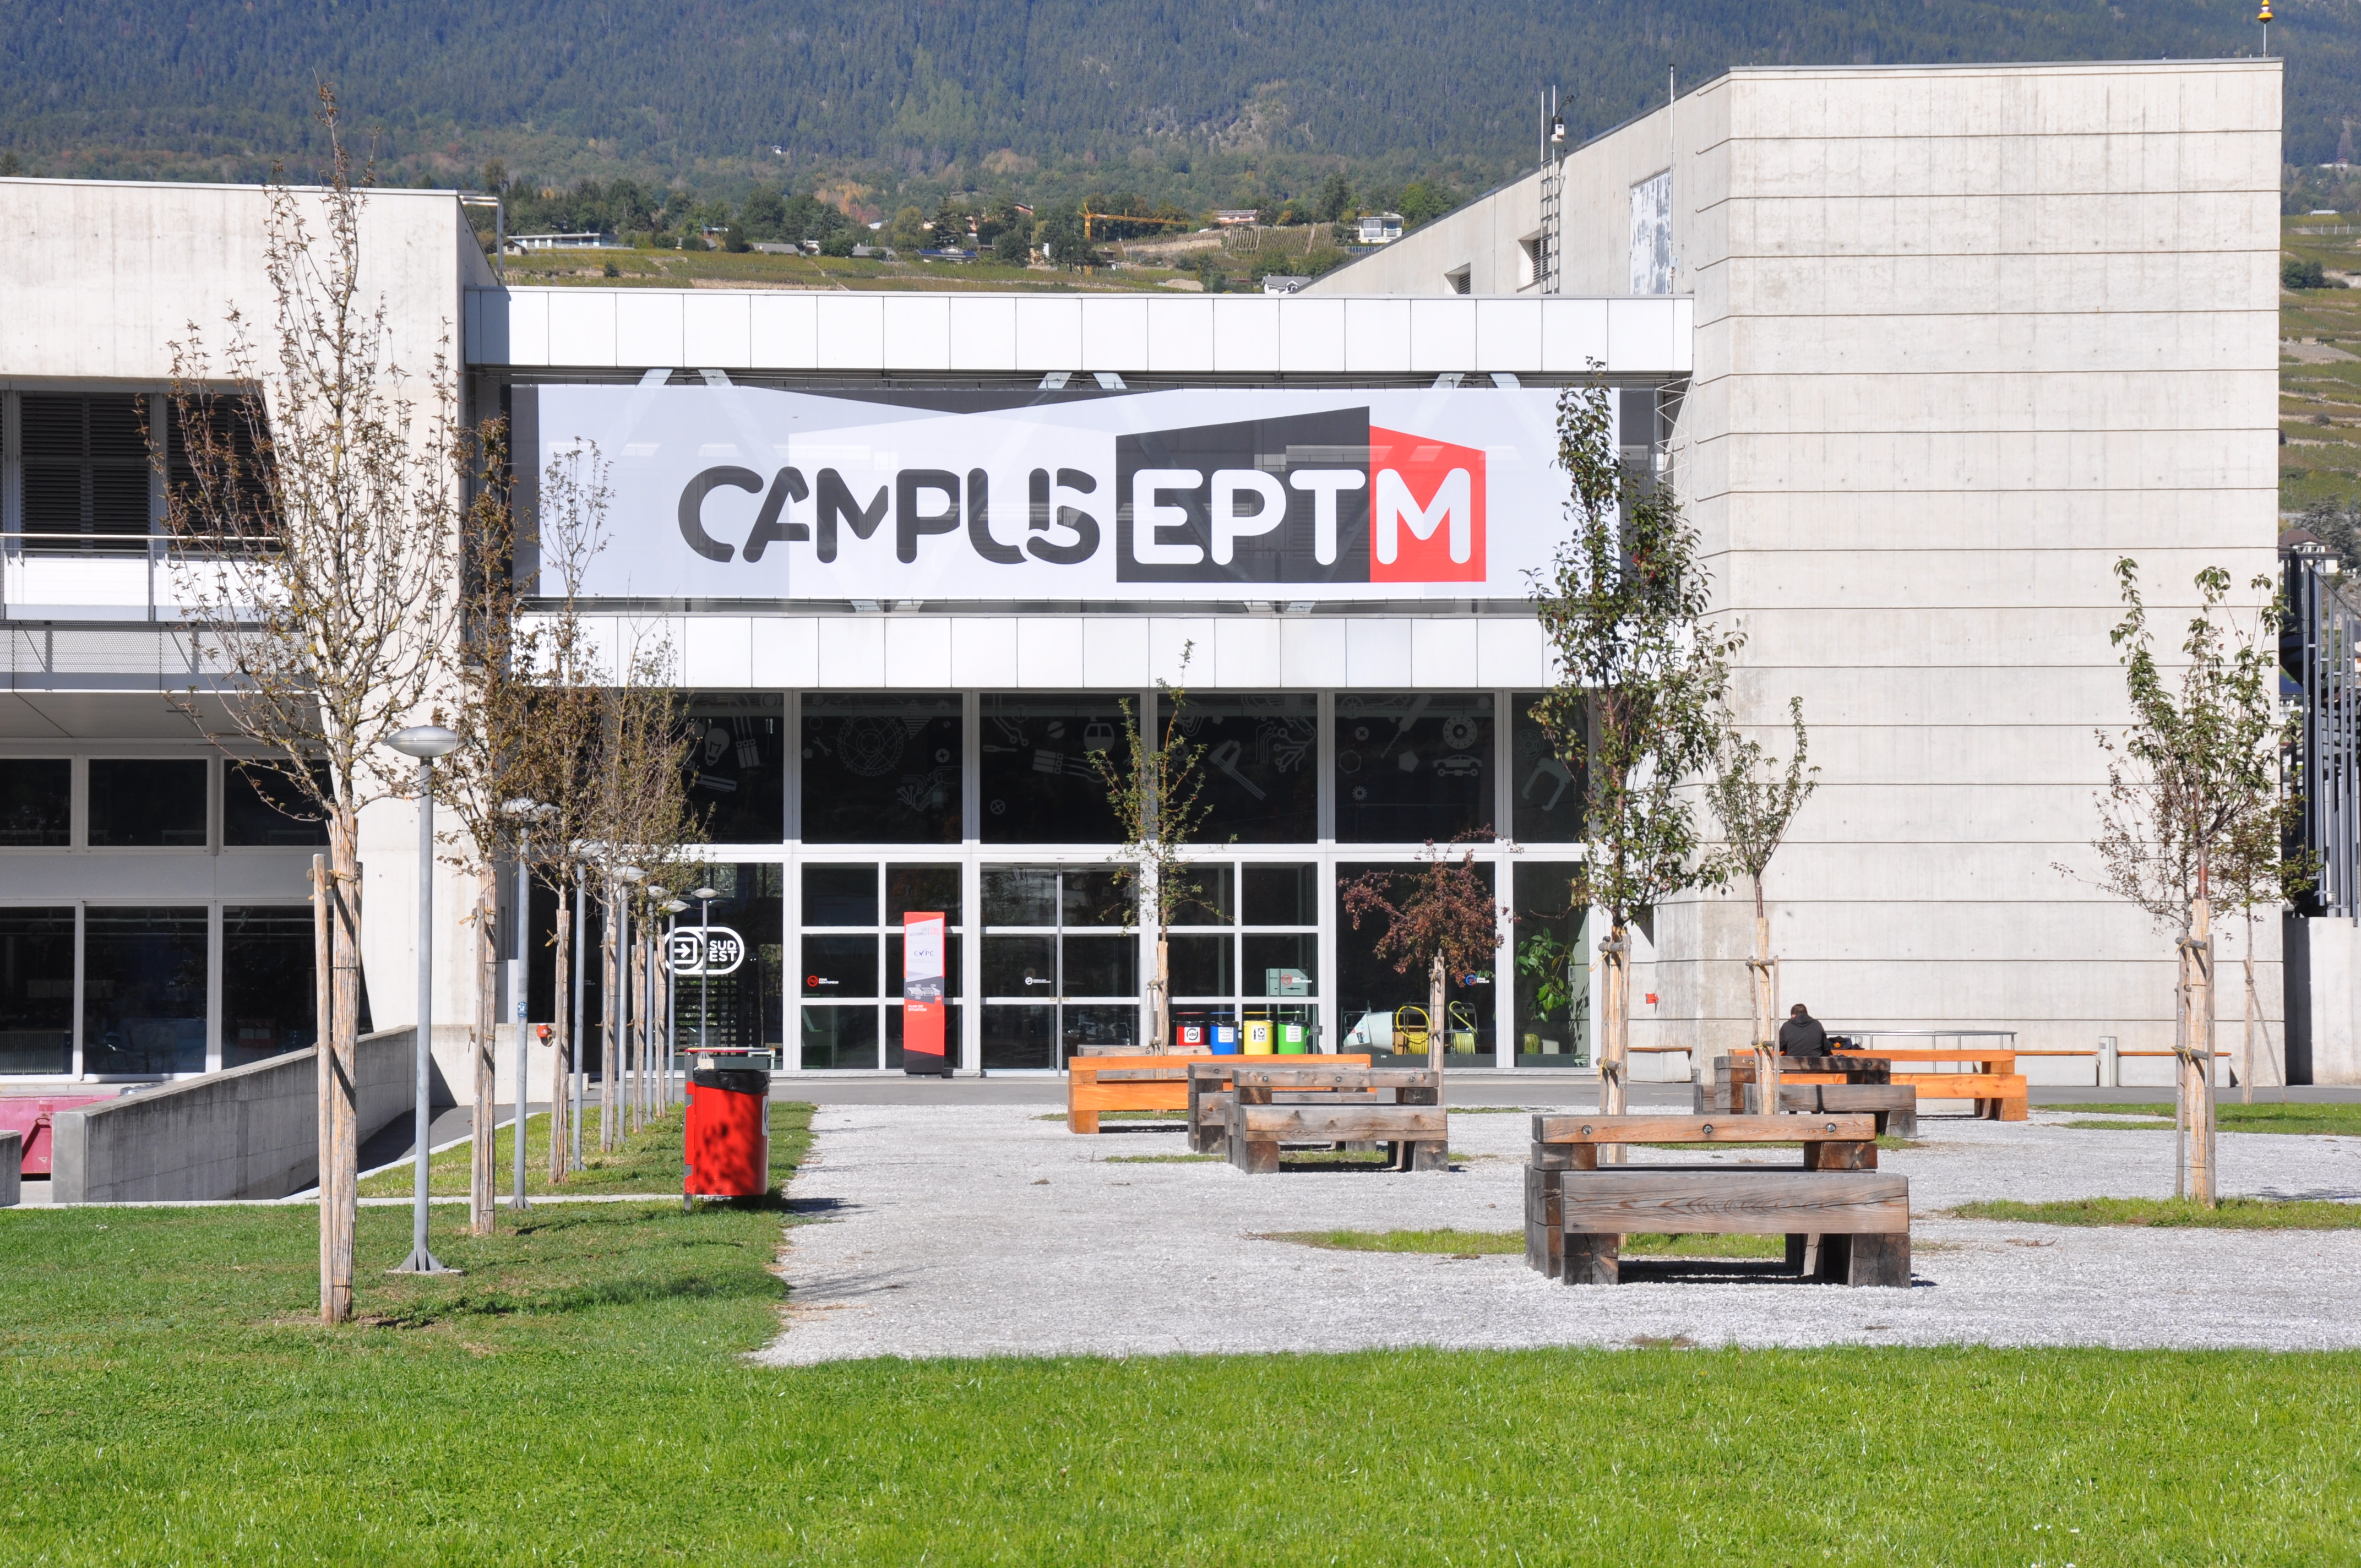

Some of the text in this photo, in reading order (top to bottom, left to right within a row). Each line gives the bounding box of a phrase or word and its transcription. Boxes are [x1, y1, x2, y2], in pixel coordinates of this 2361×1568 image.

[678, 465, 1471, 565] CAMPUS EPTM
[709, 940, 736, 950] SUD
[709, 950, 737, 962] EST
